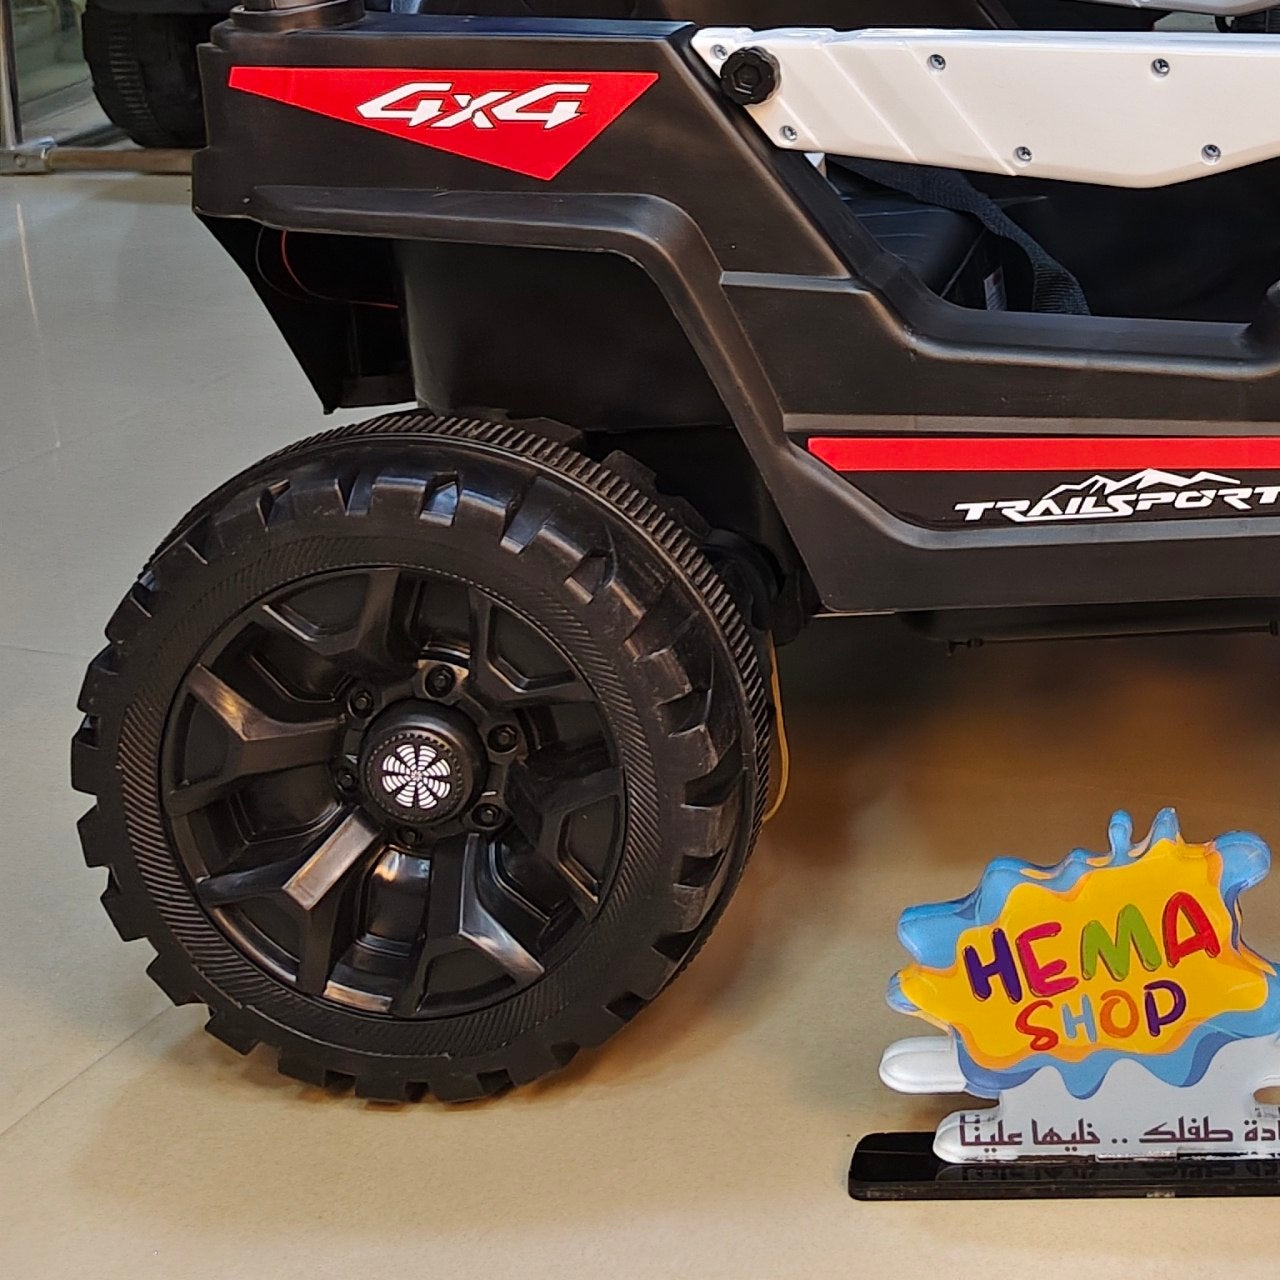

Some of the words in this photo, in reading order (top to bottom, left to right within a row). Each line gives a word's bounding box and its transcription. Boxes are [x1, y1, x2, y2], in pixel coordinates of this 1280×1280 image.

[963, 891, 1221, 1004] HEMA
[1015, 979, 1187, 1052] SHOP
[958, 1119, 1023, 1154] علينا
[1031, 1117, 1101, 1153] خليها
[1138, 1115, 1234, 1144] طفلك
